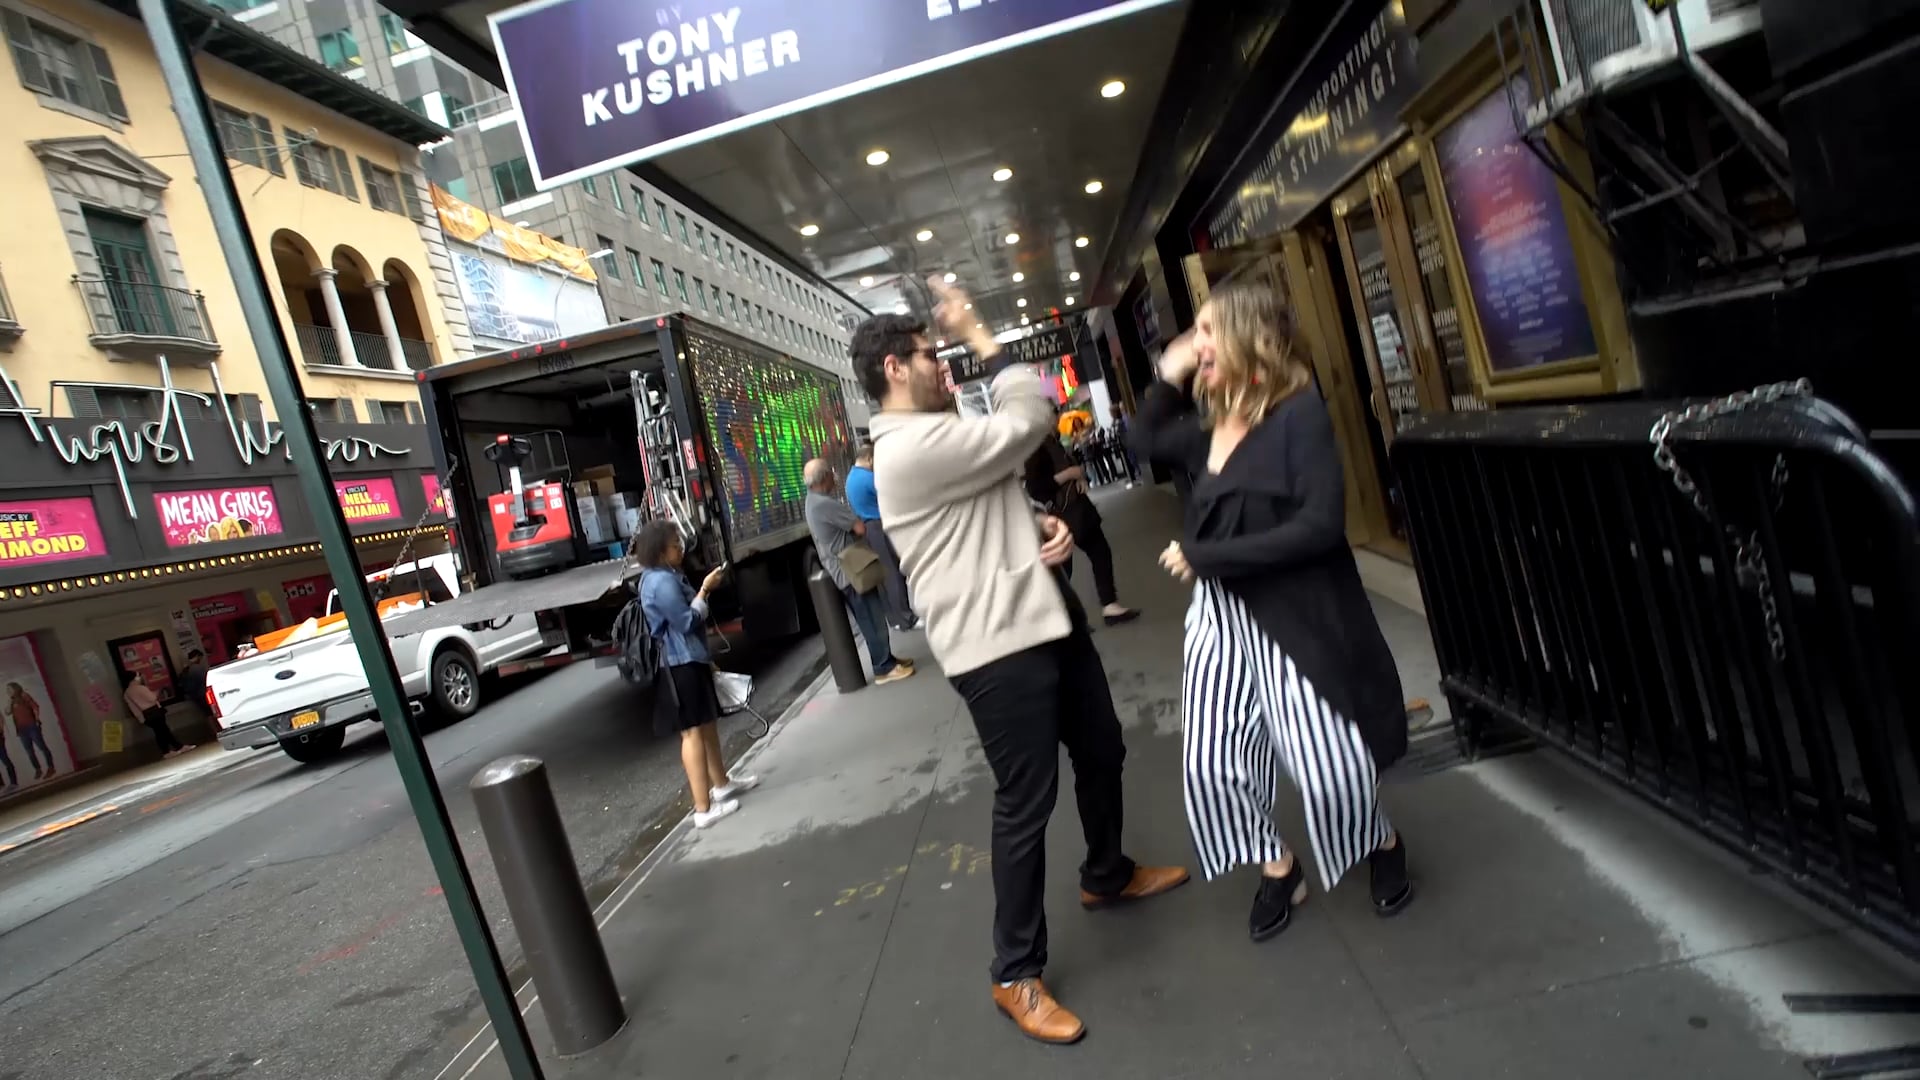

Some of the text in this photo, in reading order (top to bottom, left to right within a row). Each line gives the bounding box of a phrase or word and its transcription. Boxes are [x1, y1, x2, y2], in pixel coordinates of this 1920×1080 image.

[617, 7, 741, 75] TONY
[582, 29, 801, 126] KUSHNER
[161, 490, 273, 528] MEAN GIRLS
[344, 491, 372, 505] NELL
[0, 519, 39, 539] EFF
[18, 513, 29, 521] BY
